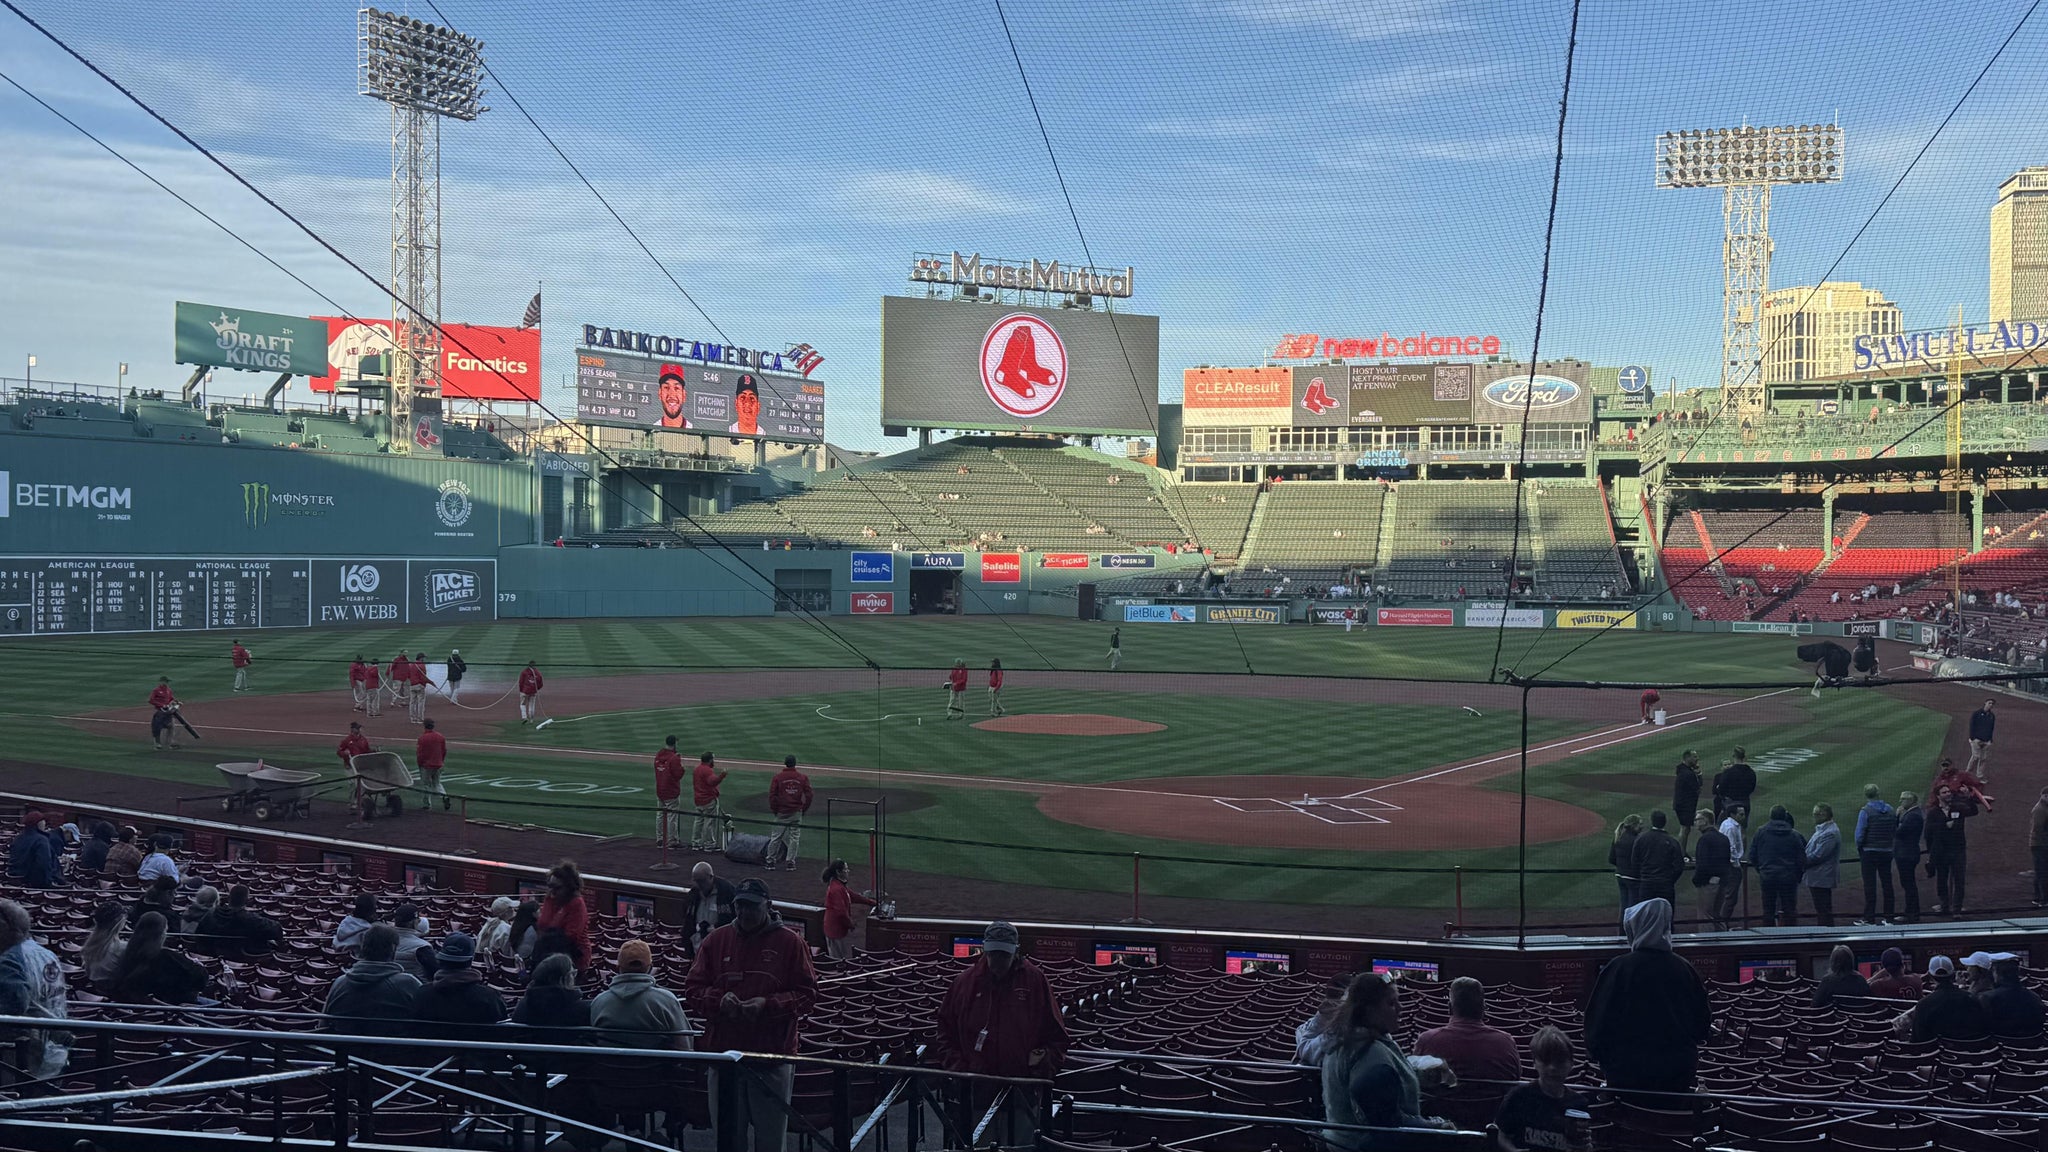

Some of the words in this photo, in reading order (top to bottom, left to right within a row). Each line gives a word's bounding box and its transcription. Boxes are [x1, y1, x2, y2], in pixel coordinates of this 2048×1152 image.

[951, 250, 1133, 298] MassMutual
[281, 327, 294, 335] 21+
[216, 329, 294, 354] DRAFT
[1323, 338, 1379, 357] new
[1382, 330, 1500, 357] balance
[582, 323, 649, 353] BANK
[656, 334, 684, 357] OF
[691, 342, 783, 371] AMERICA
[1854, 327, 1983, 371] SAMUEL
[225, 349, 291, 370] KINGS
[447, 352, 528, 374] Fanatics
[580, 367, 595, 376] 2026
[595, 369, 617, 379] SEASON
[1352, 367, 1375, 375] HOST
[1376, 367, 1398, 375] YOUR
[703, 371, 719, 381] 5:46
[1402, 374, 1427, 382] EVENT
[1195, 381, 1281, 394] CLEAResult
[1364, 382, 1398, 390] FENWAY
[1502, 379, 1560, 404] Ford
[582, 389, 589, 397] 12
[595, 391, 606, 399] 13.1
[641, 395, 649, 404] 22
[698, 396, 726, 407] PITCHING
[591, 405, 606, 415] 4.73
[623, 409, 636, 417] 1.43
[697, 406, 726, 417] MATCHUP
[769, 409, 776, 417] 27
[1363, 450, 1401, 458] ANGRY
[1754, 450, 1771, 462] 27
[1831, 448, 1847, 460] 45
[1908, 443, 1922, 456] 42
[546, 460, 590, 472] ABIOMED
[1356, 458, 1409, 466] ORCHARD
[16, 483, 131, 509] BETMGM
[195, 562, 236, 570] NATIONAL
[853, 559, 868, 568] city
[982, 562, 1019, 571] Safelite
[1061, 557, 1088, 567] TICKET
[0, 571, 7, 579] R
[12, 571, 19, 579] H
[23, 571, 29, 579] E
[38, 571, 44, 579] P
[82, 571, 88, 579] R
[97, 571, 103, 579] P
[340, 564, 380, 593] 160
[1, 582, 6, 590] 2
[50, 581, 65, 589] LAA
[107, 581, 123, 589] HOU
[224, 580, 236, 588] STL
[436, 572, 475, 592] ACE
[71, 585, 78, 593] N
[129, 584, 135, 592] N
[169, 588, 183, 596] LAD
[50, 589, 65, 597] SEA
[109, 589, 122, 597] ATH
[436, 588, 475, 604] TICKET
[498, 593, 516, 602] 379
[1003, 592, 1018, 600] 420
[170, 596, 182, 604] MIL
[857, 598, 888, 608] IRVING
[321, 605, 350, 621] F.W.
[354, 604, 398, 620] WEBB
[1129, 607, 1165, 621] jetBlue
[1209, 608, 1253, 621] GRANITE
[1254, 608, 1278, 621] CITY
[53, 614, 63, 622] TB
[1571, 614, 1605, 627] TWISTED
[50, 622, 65, 630] NYY
[900, 933, 940, 941] CAUTION!
[1036, 938, 1077, 947] CAUTION!
[1308, 952, 1351, 962] CAUTION!
[1545, 961, 1585, 970] CAUTION!
